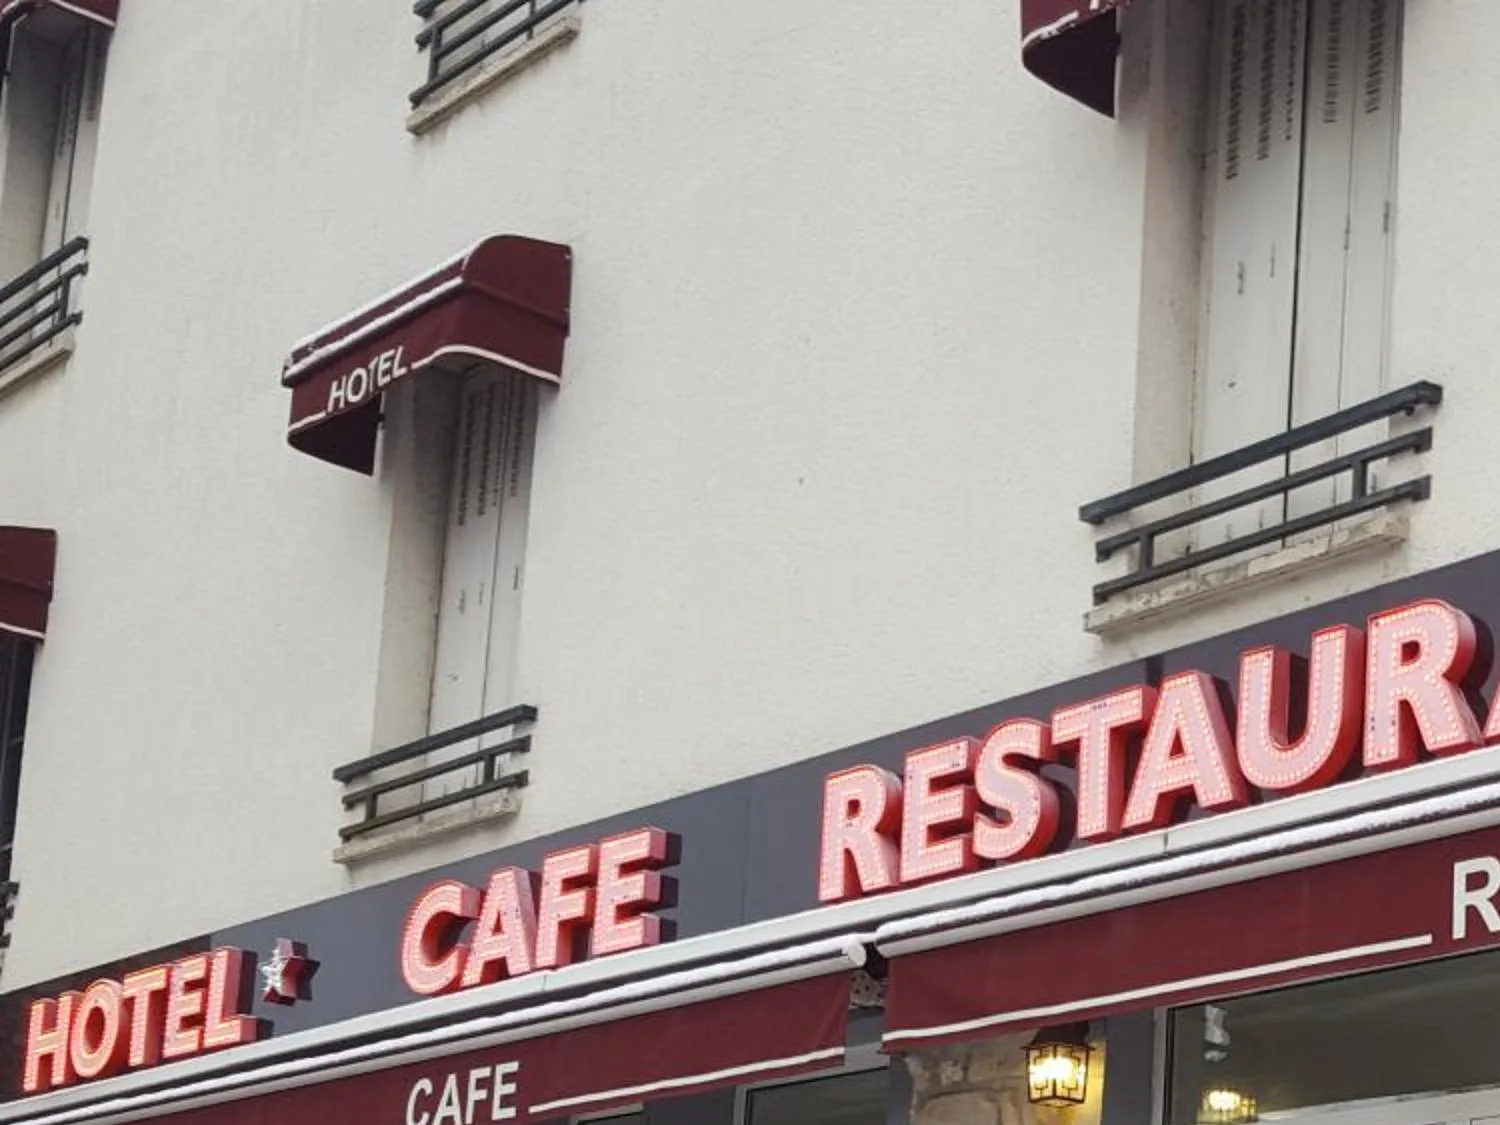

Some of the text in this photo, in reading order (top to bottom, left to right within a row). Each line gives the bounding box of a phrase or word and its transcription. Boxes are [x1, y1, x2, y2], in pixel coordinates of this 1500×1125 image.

[328, 345, 407, 412] HOTEL
[401, 827, 670, 995] CAFE
[23, 946, 258, 1092] HOTEL
